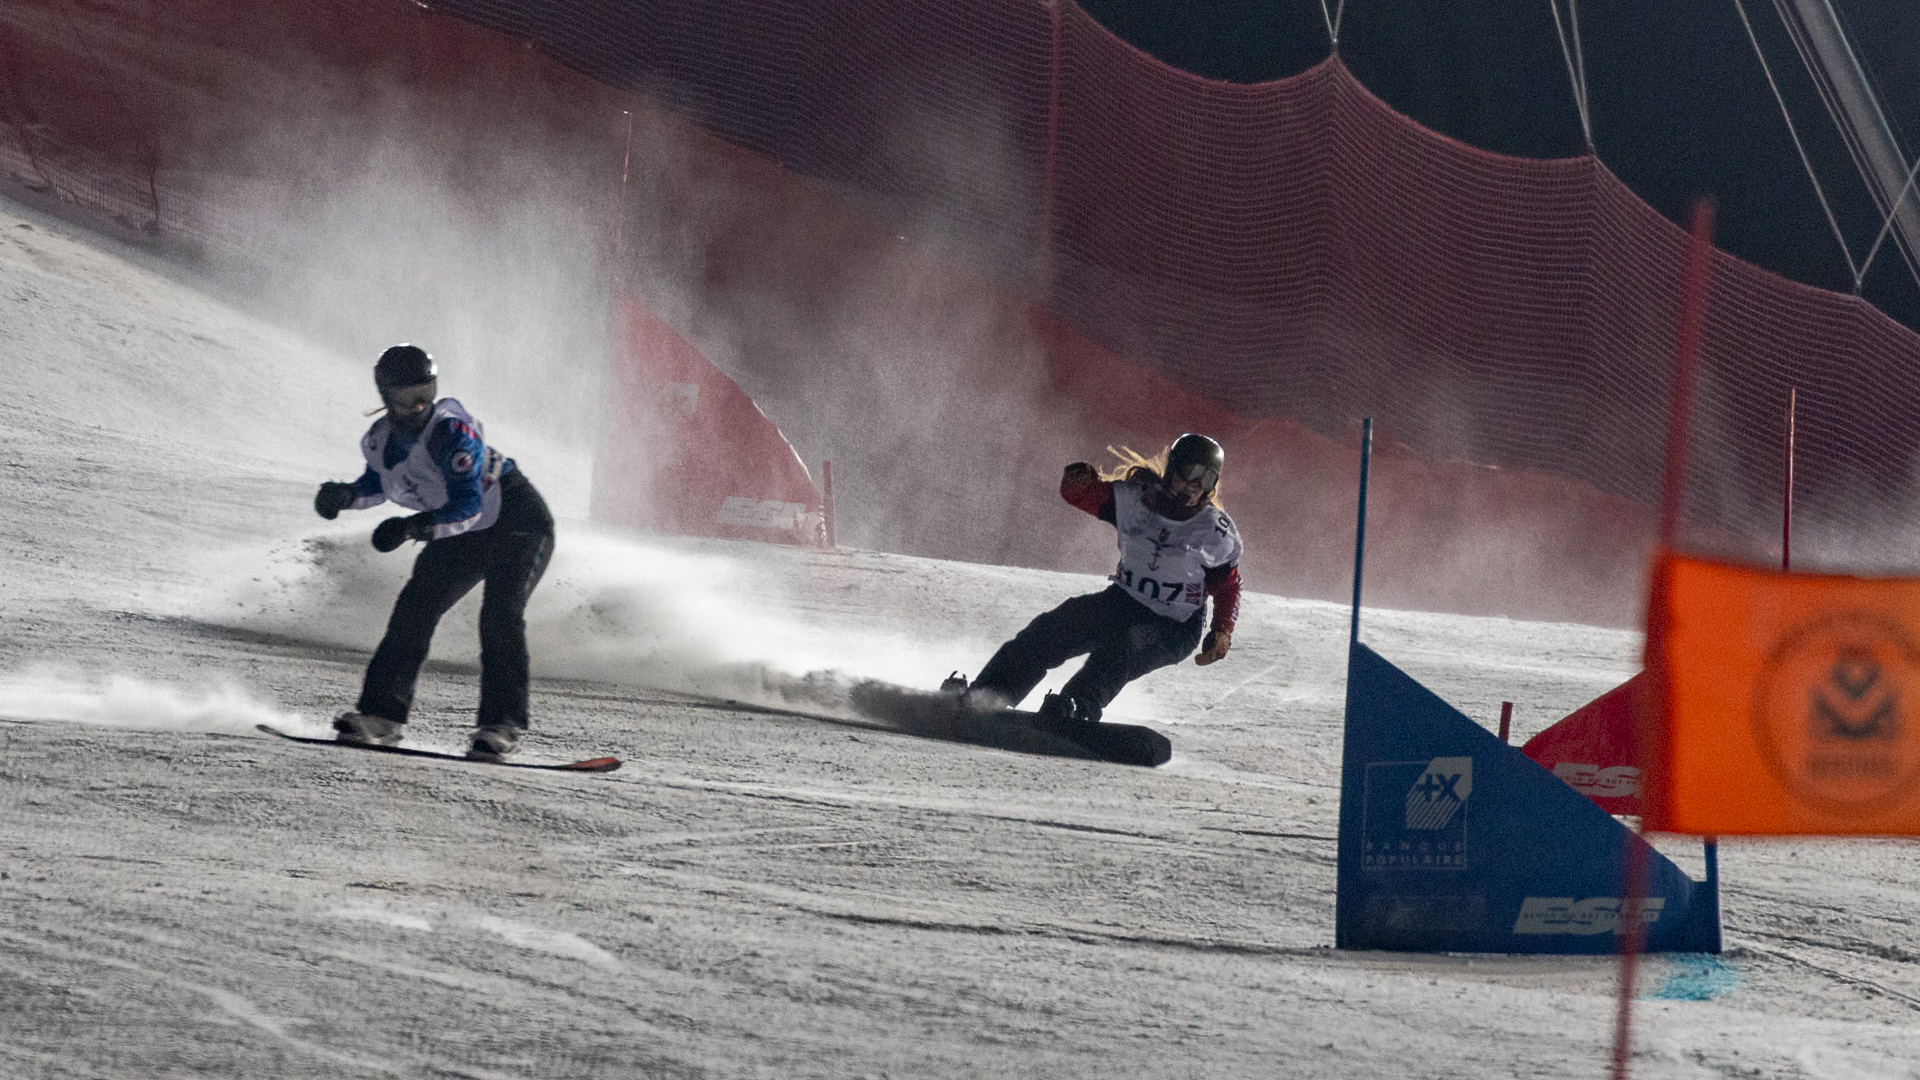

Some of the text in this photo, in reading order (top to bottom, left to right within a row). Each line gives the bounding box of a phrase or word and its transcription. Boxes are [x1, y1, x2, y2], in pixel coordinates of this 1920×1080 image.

[1124, 571, 1184, 602] 107
[1552, 762, 1644, 799] ES
[1365, 854, 1463, 866] POPULAIRE
[1513, 896, 1665, 935] ESF
